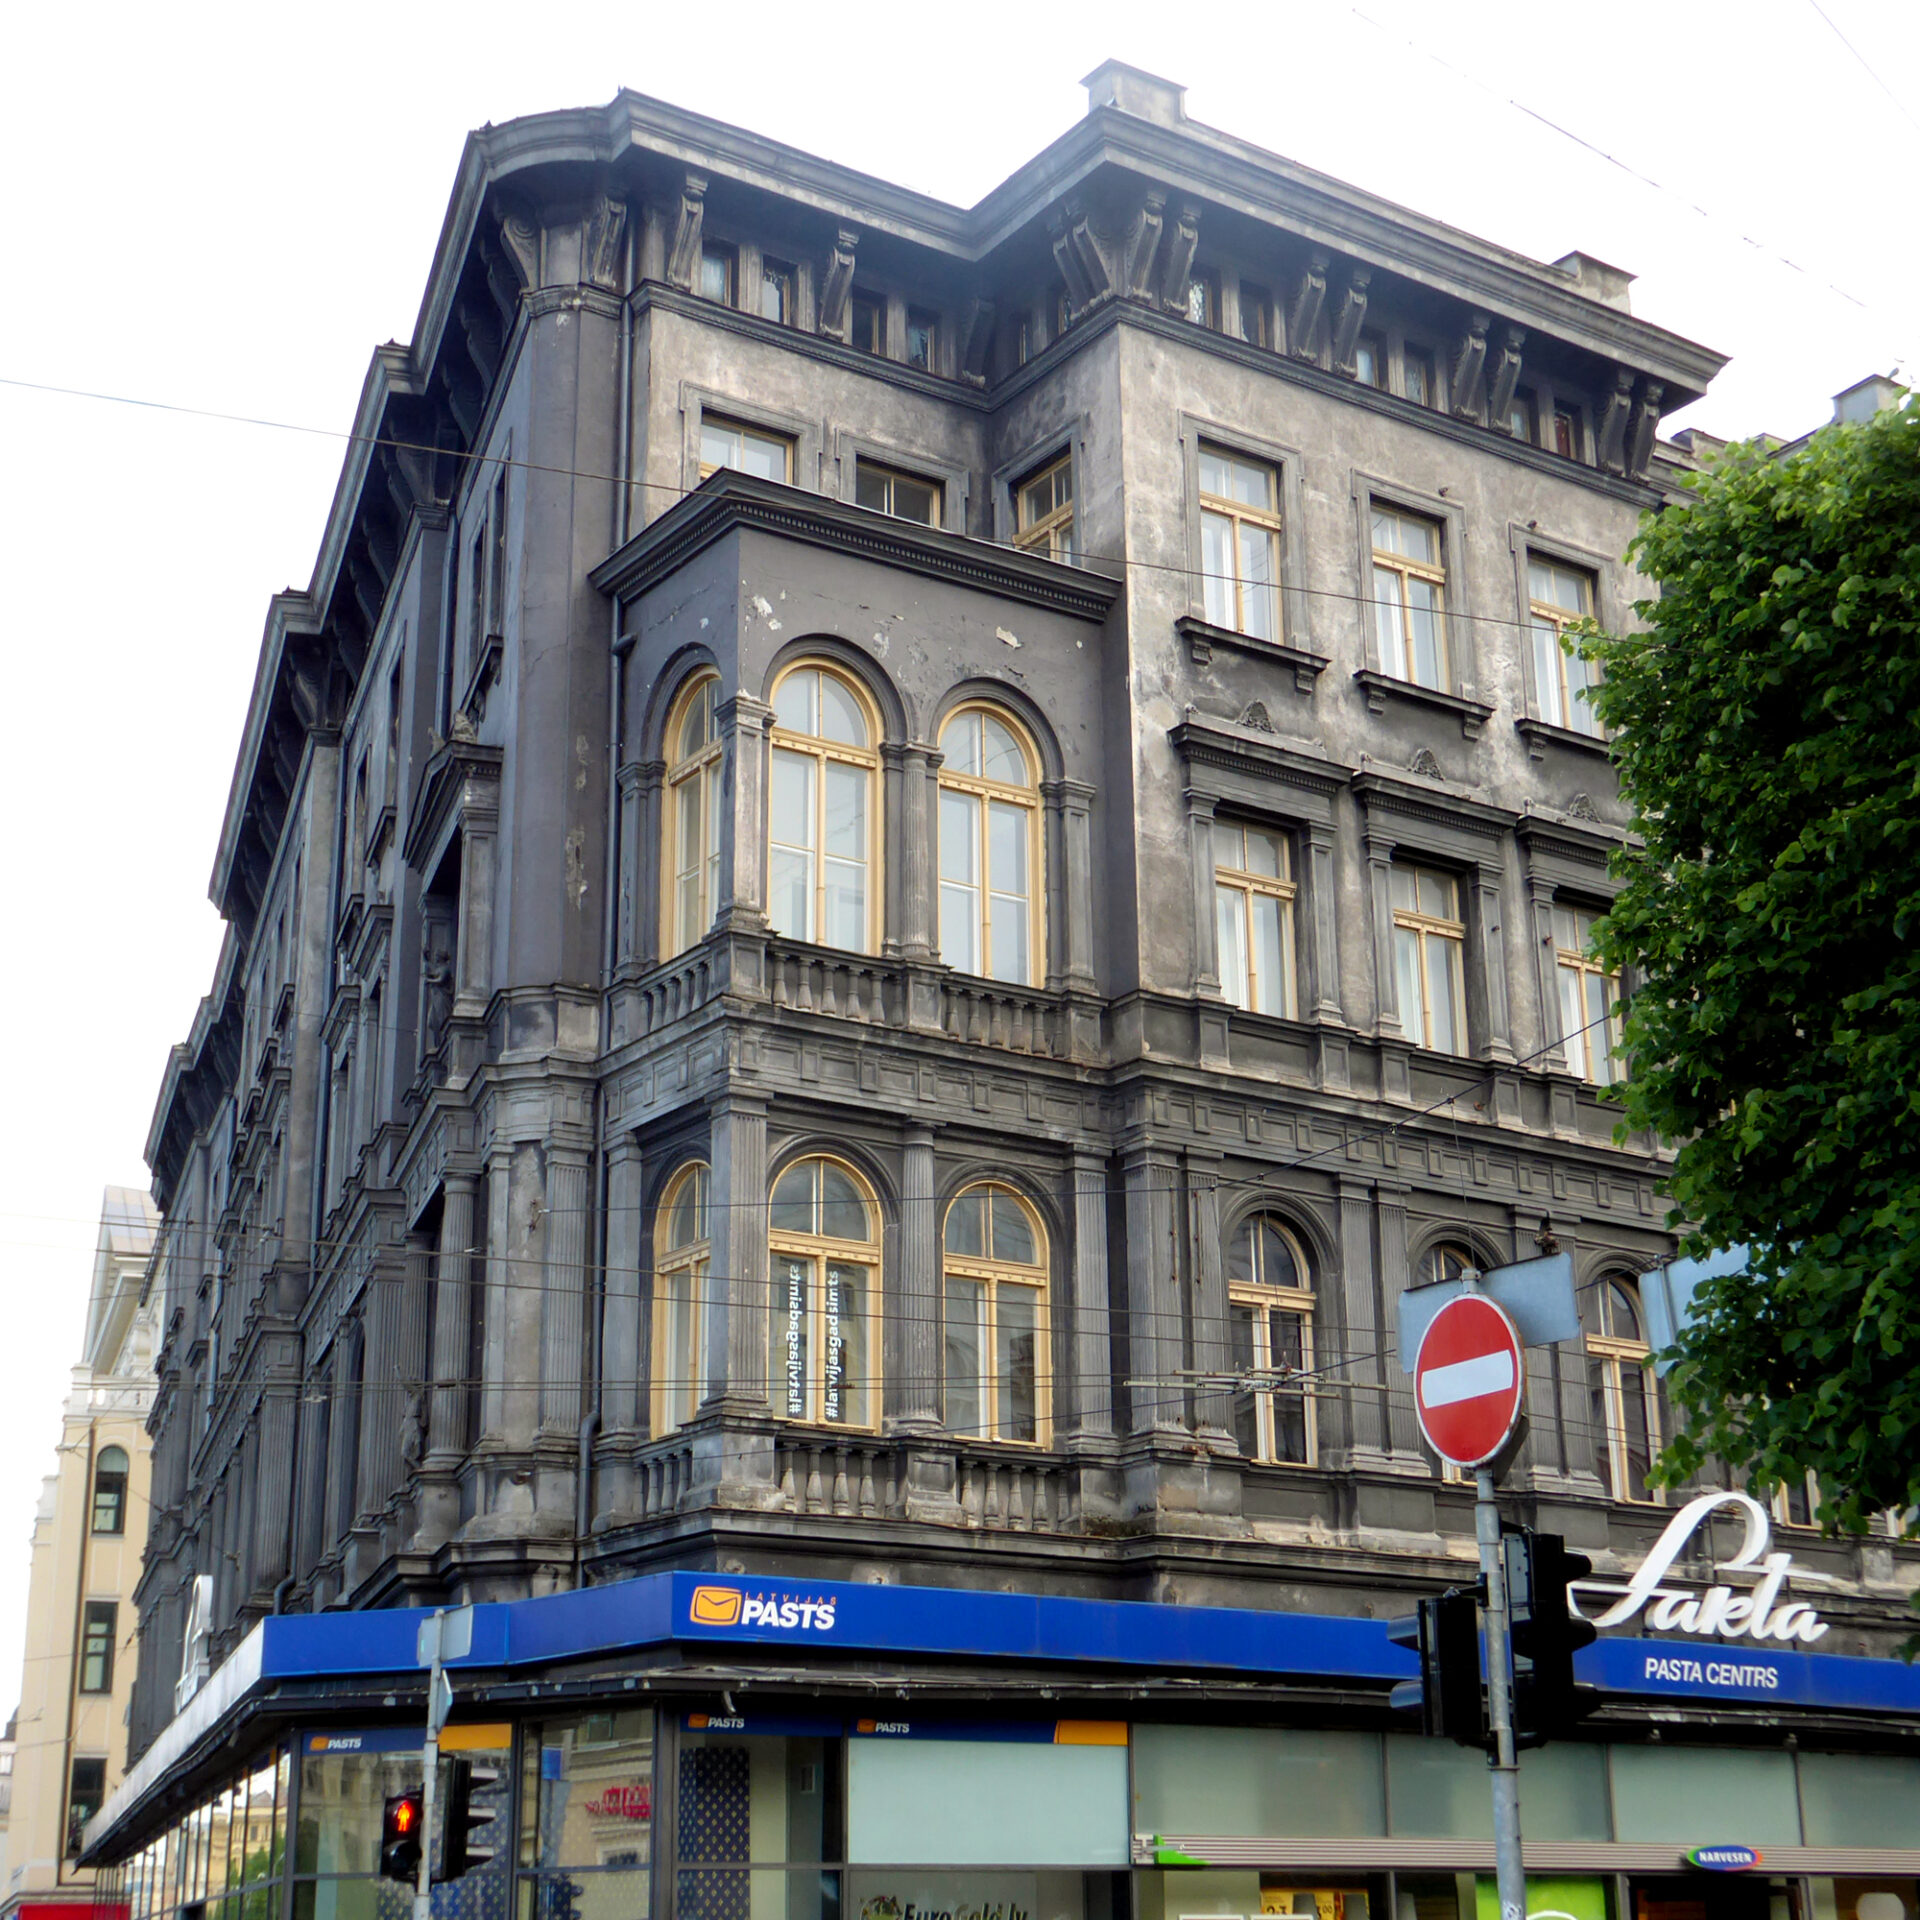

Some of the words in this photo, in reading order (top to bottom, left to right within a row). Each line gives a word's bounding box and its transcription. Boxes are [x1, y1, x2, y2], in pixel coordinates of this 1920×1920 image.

[745, 1592, 837, 1606] LATVIJAS
[741, 1600, 836, 1631] PASTS
[1645, 1657, 1703, 1683] PASTA
[1706, 1662, 1778, 1689] CENTRS
[708, 1717, 744, 1729] PASTS
[875, 1720, 909, 1733] PASTS
[328, 1737, 362, 1749] PASTS
[1698, 1851, 1754, 1864] NARVESEN
